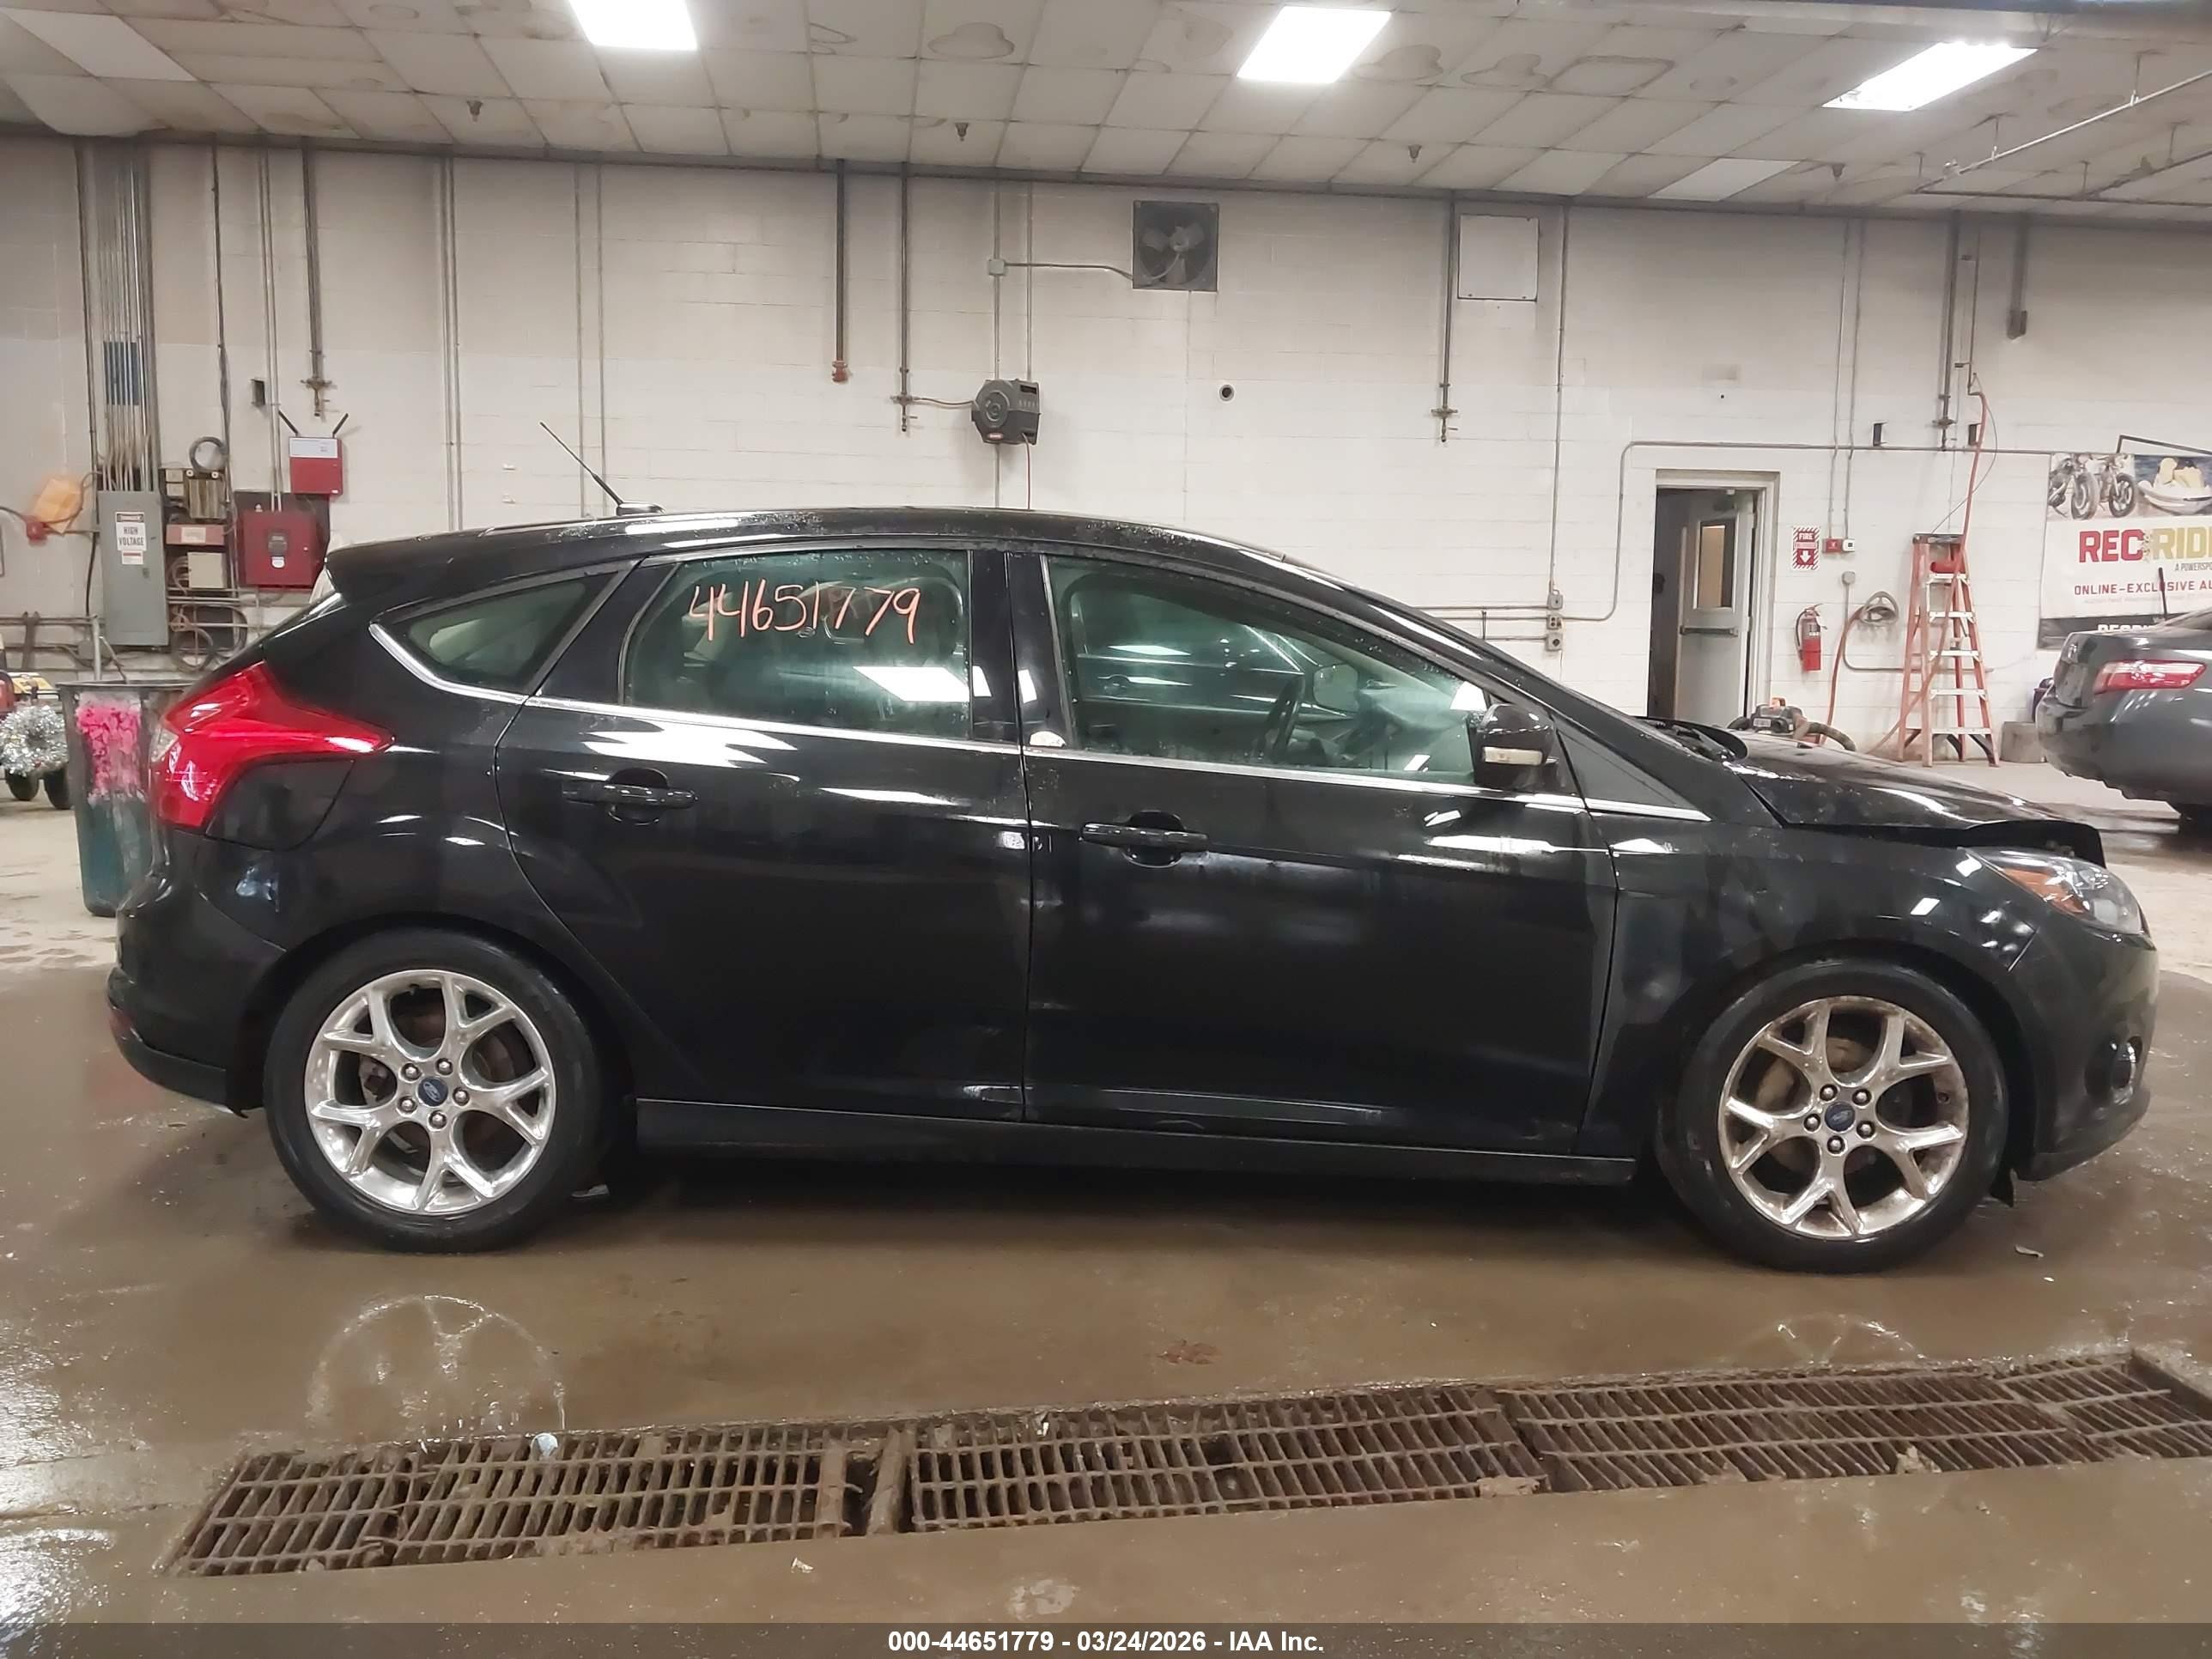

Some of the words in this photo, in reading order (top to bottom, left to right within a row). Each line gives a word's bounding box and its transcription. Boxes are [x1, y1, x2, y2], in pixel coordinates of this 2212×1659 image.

[118, 537, 144, 546] VOLTAGE
[2079, 529, 2144, 563] REC
[2152, 526, 2212, 560] RID
[688, 578, 921, 644] 44651779
